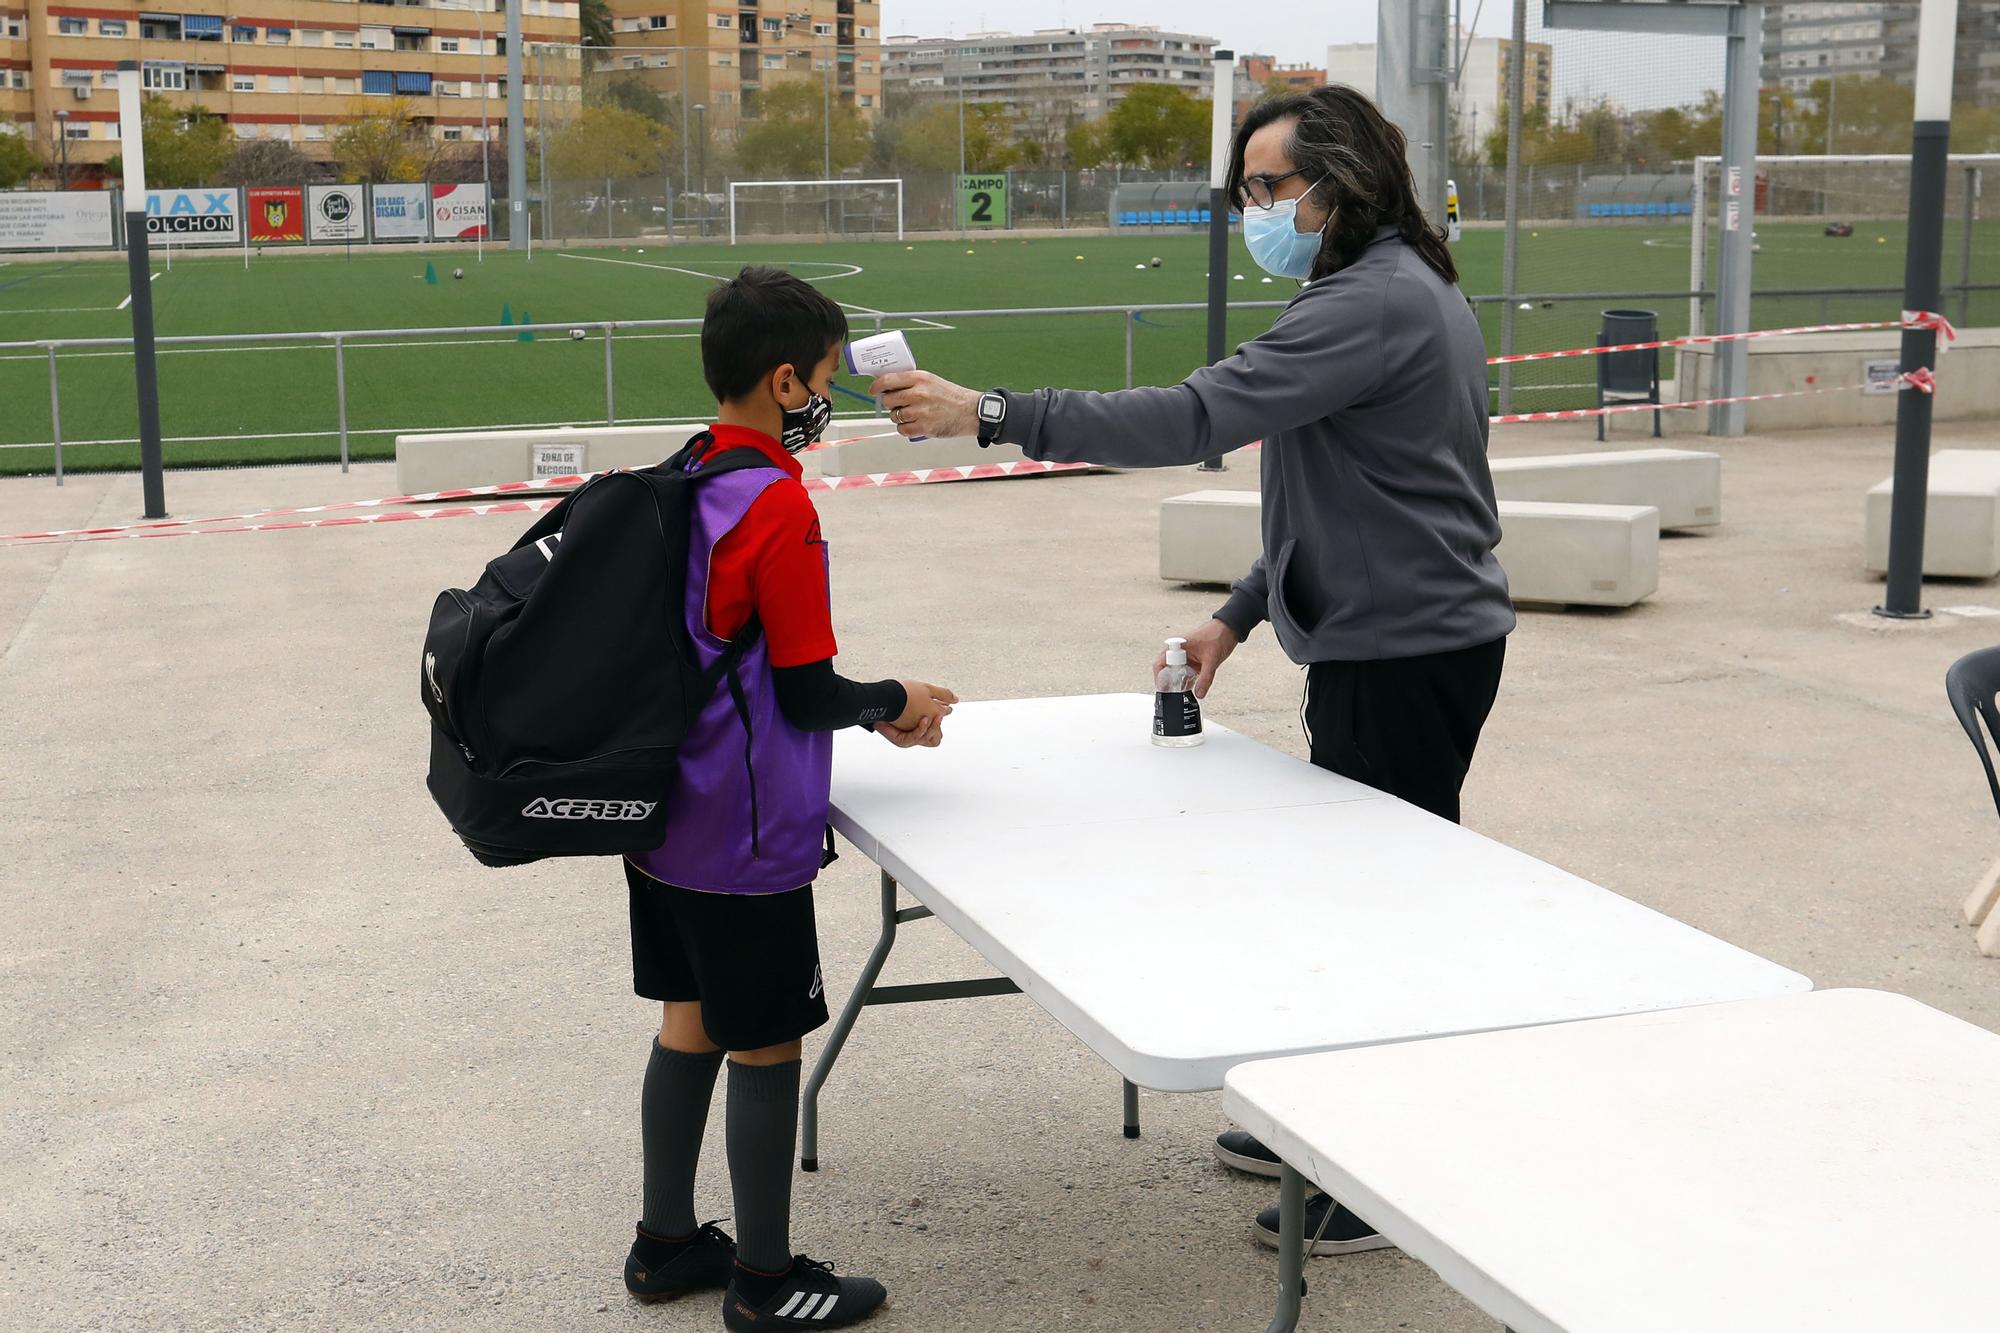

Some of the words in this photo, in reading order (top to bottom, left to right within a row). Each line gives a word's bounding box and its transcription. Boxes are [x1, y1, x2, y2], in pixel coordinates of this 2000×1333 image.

[960, 179, 1004, 190] CAMPO
[376, 196, 387, 206] BIG
[388, 196, 405, 206] BAGS
[376, 206, 406, 218] DISAKA
[452, 206, 485, 215] CISAN
[971, 192, 992, 222] 2
[146, 216, 233, 232] OLCHON
[541, 453, 562, 462] ZONA
[564, 453, 575, 462] DE
[537, 465, 578, 474] RECOGIDA
[521, 797, 651, 820] ACERBIS
